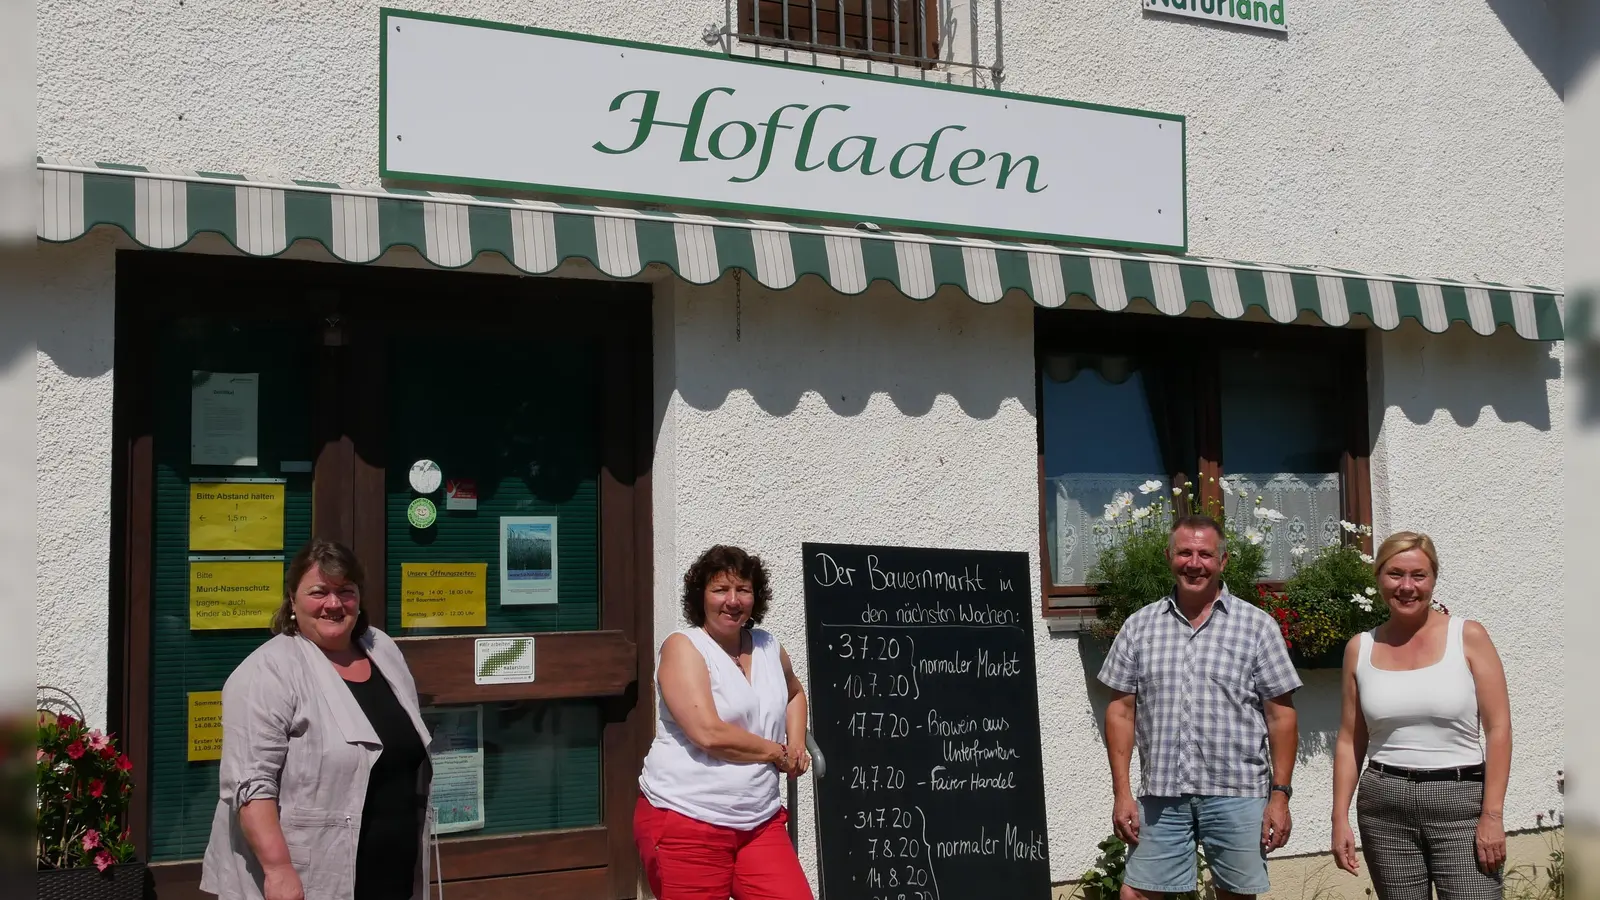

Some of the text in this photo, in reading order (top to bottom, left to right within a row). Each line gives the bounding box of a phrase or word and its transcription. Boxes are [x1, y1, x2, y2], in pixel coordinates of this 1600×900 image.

[592, 86, 1049, 194] Hofladen
[814, 552, 1014, 592] Der Bauernmarkt in
[861, 601, 1020, 624] den nächsten Wochen:
[839, 634, 1021, 678] 3.7.20 normaler Markt
[844, 673, 909, 699] 10.7.20
[927, 709, 977, 736] Biowein
[982, 717, 1010, 731] aus
[943, 740, 1020, 766] Unterfranken
[930, 765, 967, 791] Fairer
[970, 772, 1016, 791] Handel
[868, 822, 1046, 862] 7.8.20 normaler Markt
[866, 865, 928, 888] 14.8.20
